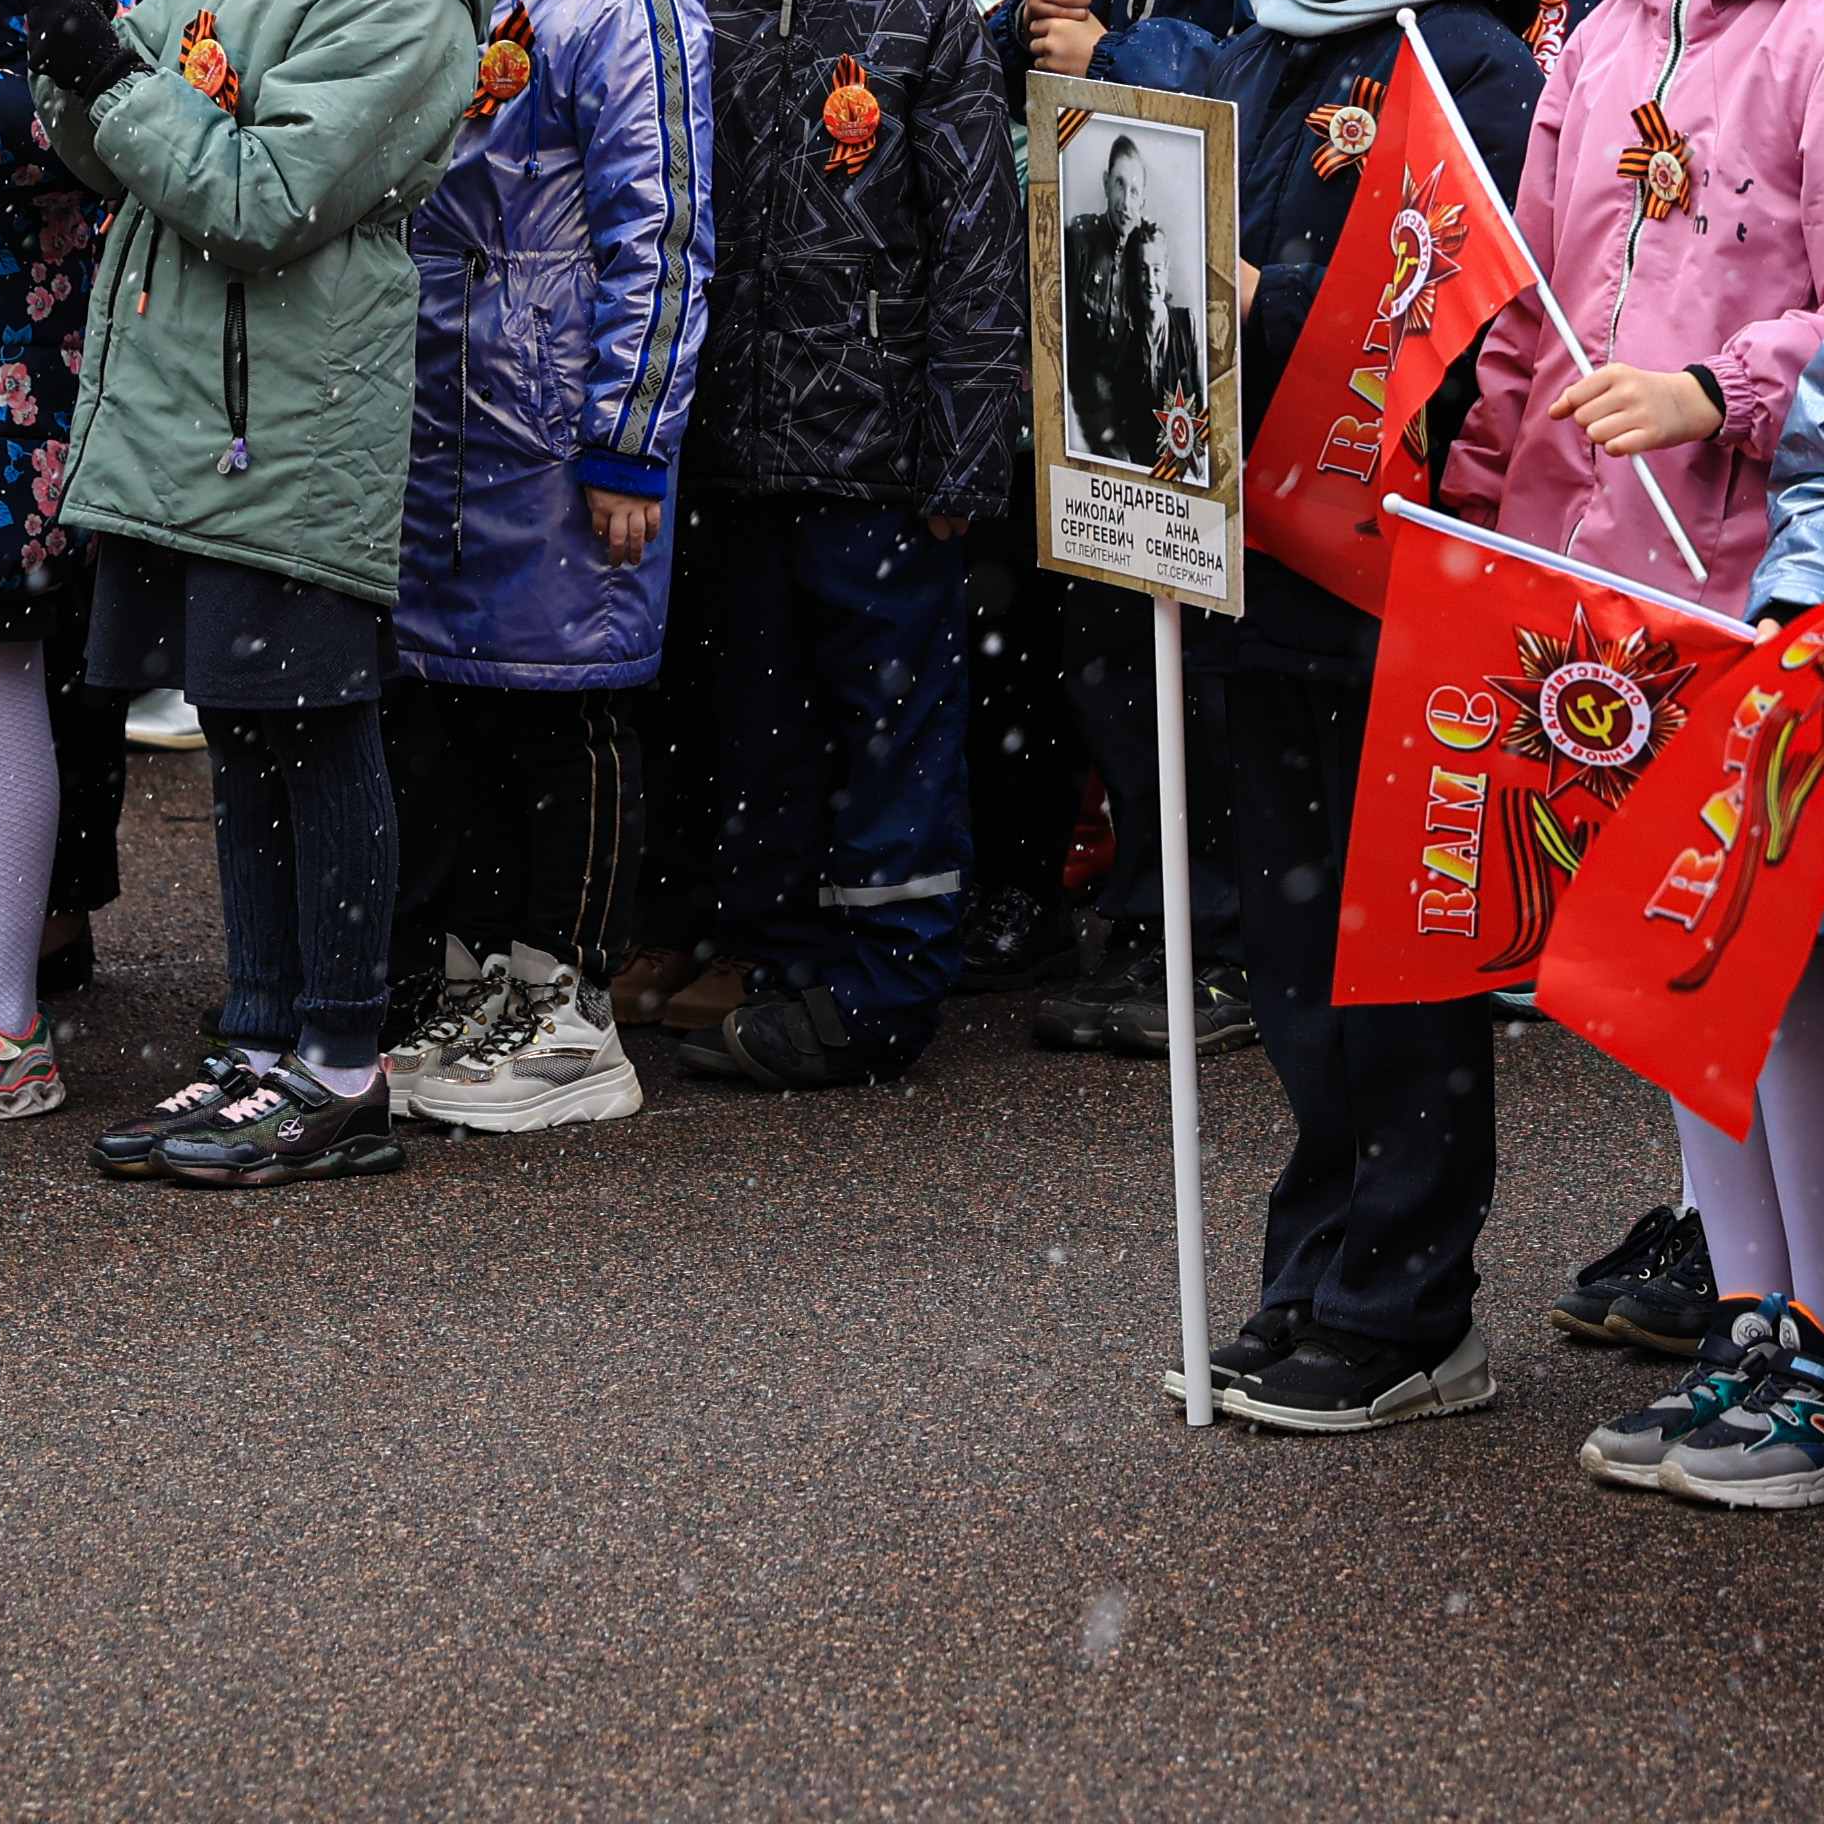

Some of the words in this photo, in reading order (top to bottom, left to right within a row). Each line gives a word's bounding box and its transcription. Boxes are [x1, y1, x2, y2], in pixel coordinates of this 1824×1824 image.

[1065, 498, 1125, 527] НИКОЛАЙ
[1090, 478, 1190, 520] БОНДАРЕВЫ
[1061, 518, 1134, 550] СЕРГЕЕВИЧ
[1165, 521, 1200, 545] АННА
[1146, 537, 1224, 573] СЕМЕНОВНА
